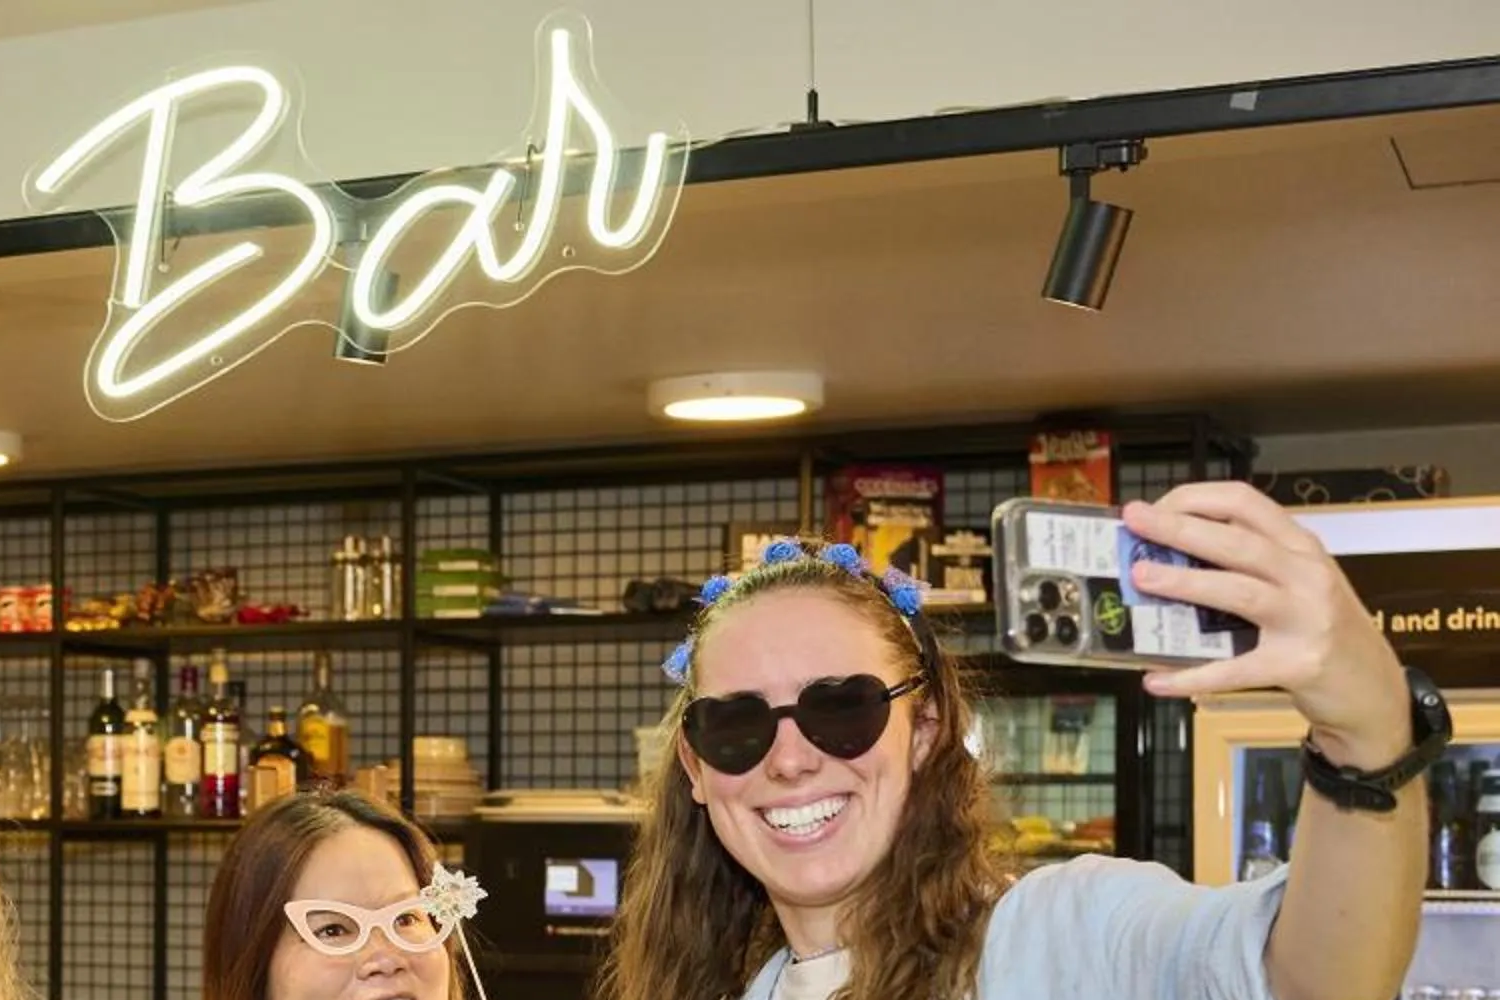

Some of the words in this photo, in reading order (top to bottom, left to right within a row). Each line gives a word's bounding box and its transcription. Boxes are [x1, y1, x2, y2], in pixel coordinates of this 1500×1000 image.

[35, 28, 670, 398] Bar
[1391, 607, 1440, 632] and
[1446, 606, 1500, 631] drin
